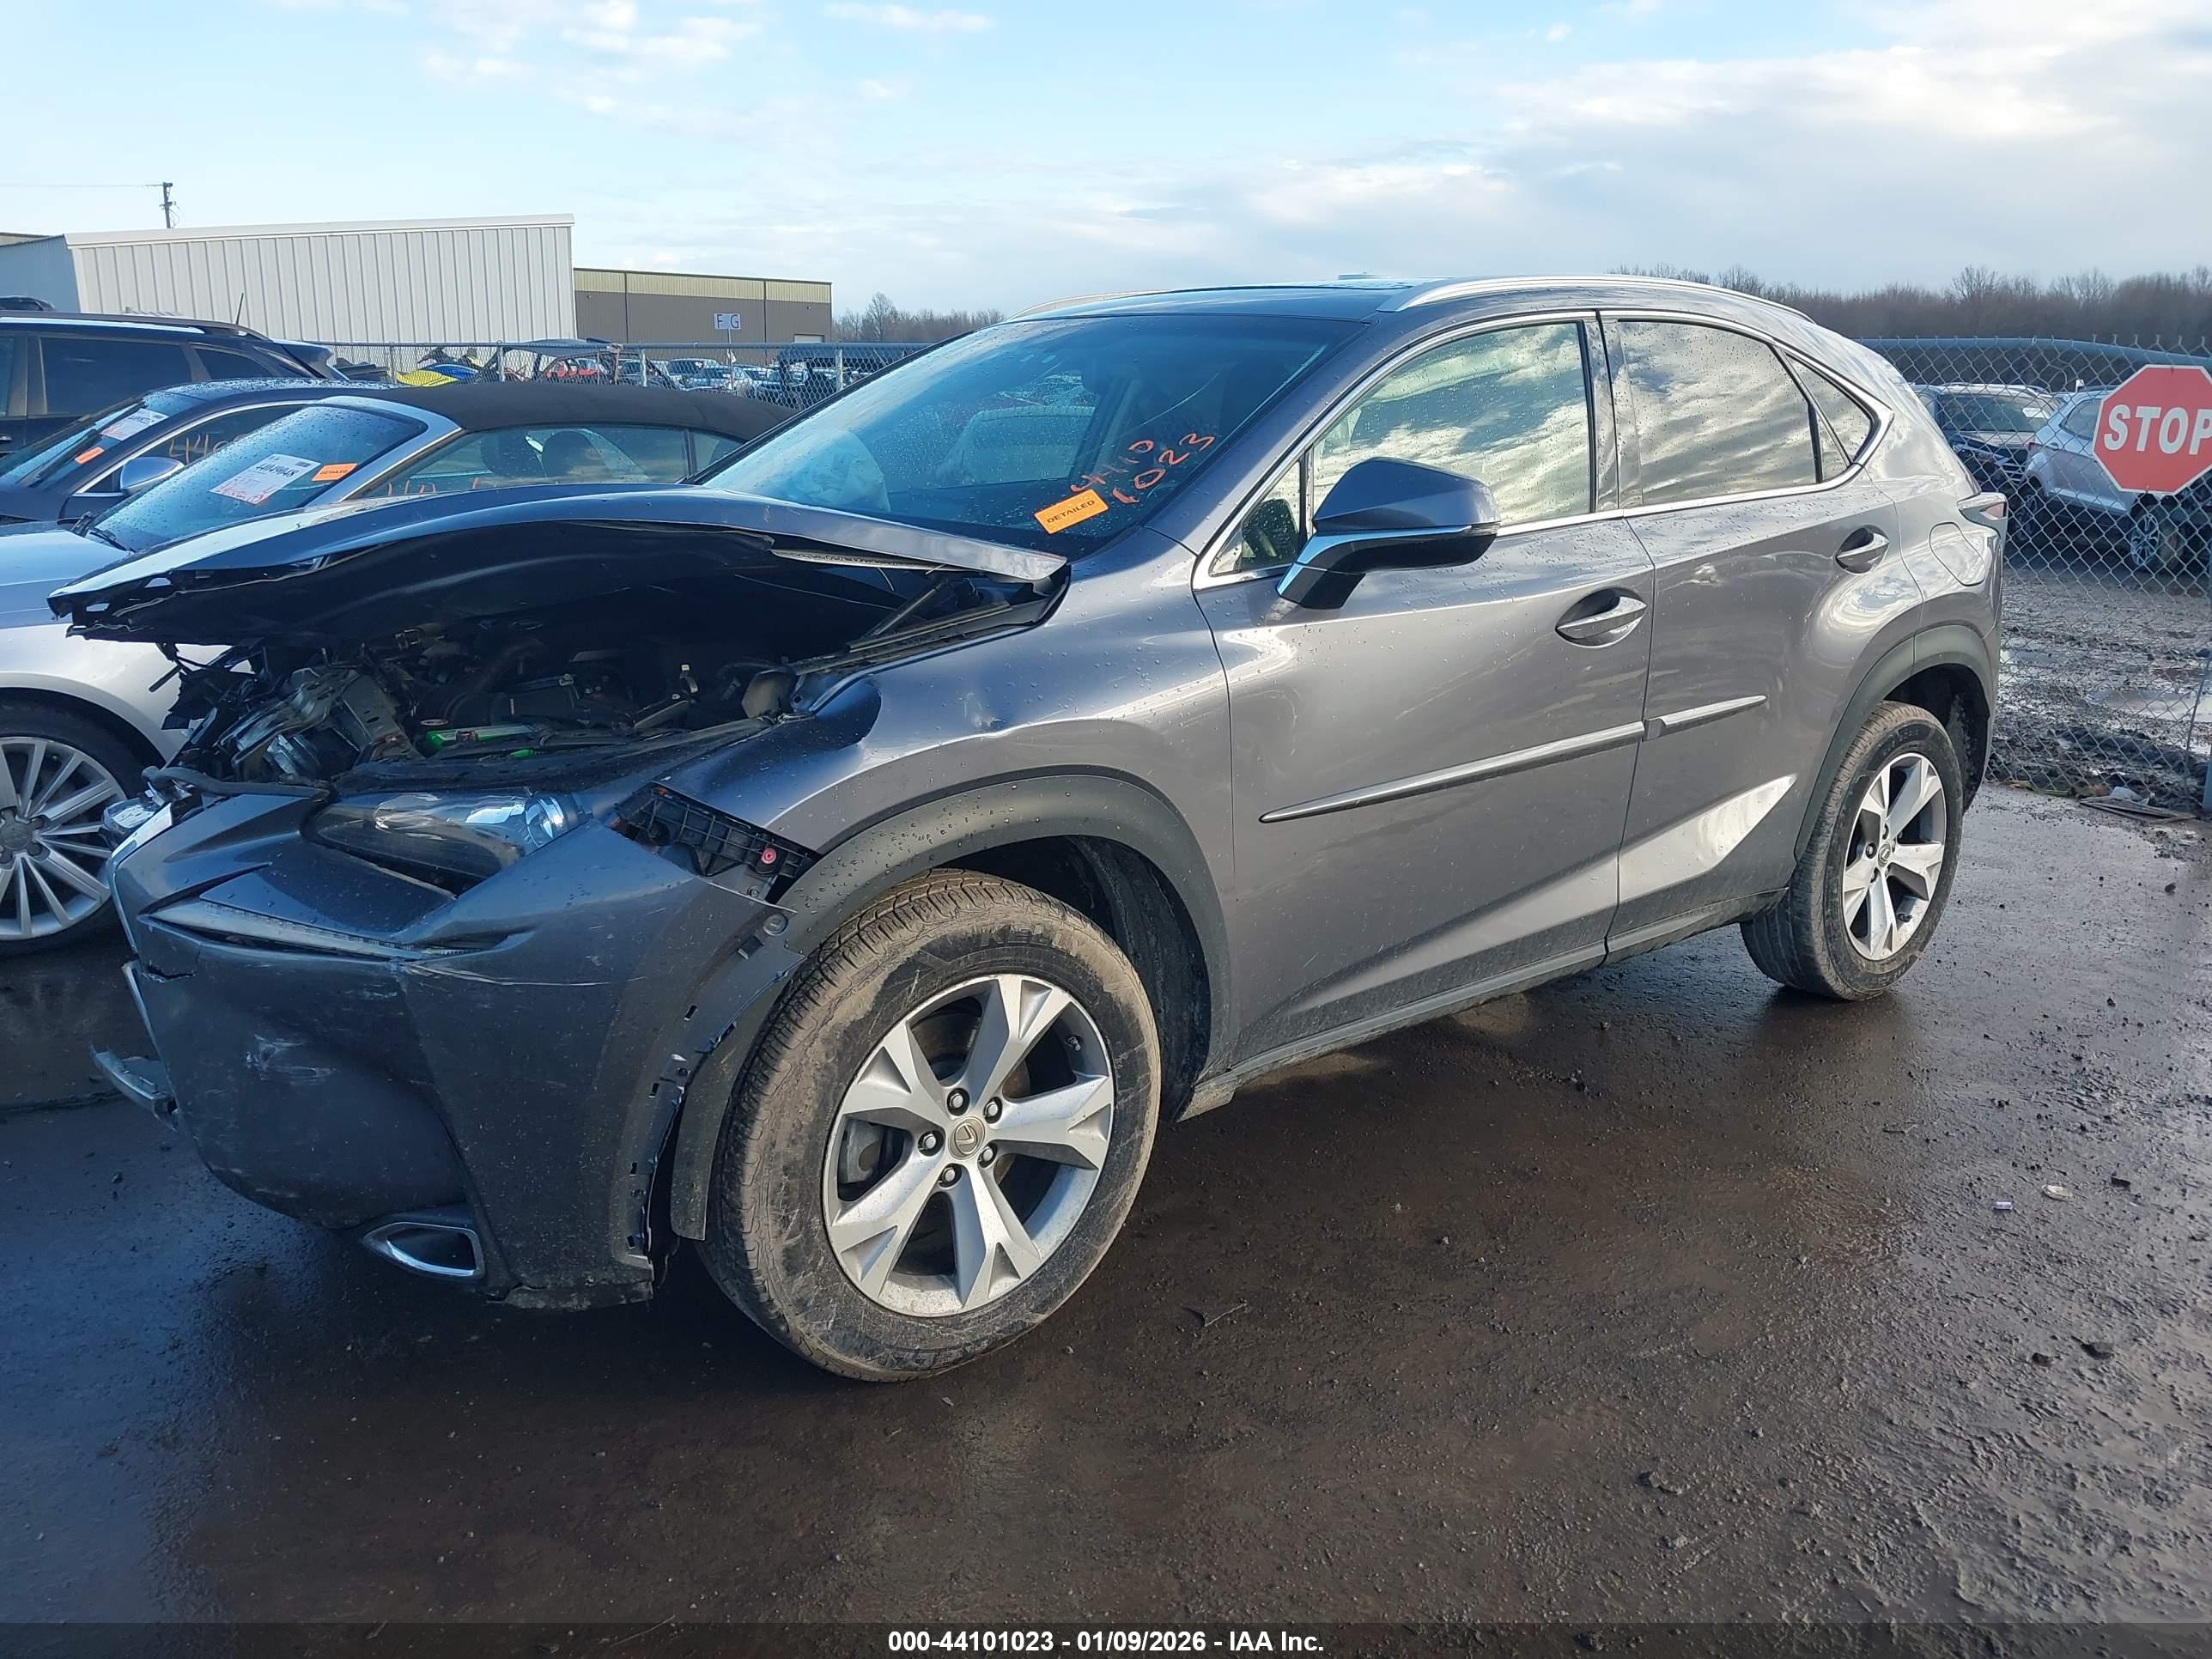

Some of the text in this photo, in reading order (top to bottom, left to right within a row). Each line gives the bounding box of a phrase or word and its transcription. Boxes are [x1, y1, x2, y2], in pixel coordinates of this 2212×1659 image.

[716, 313, 739, 329] F G
[2104, 404, 2212, 455] STOP
[1112, 433, 1215, 503] 1023
[1047, 500, 1096, 523] DETAILED
